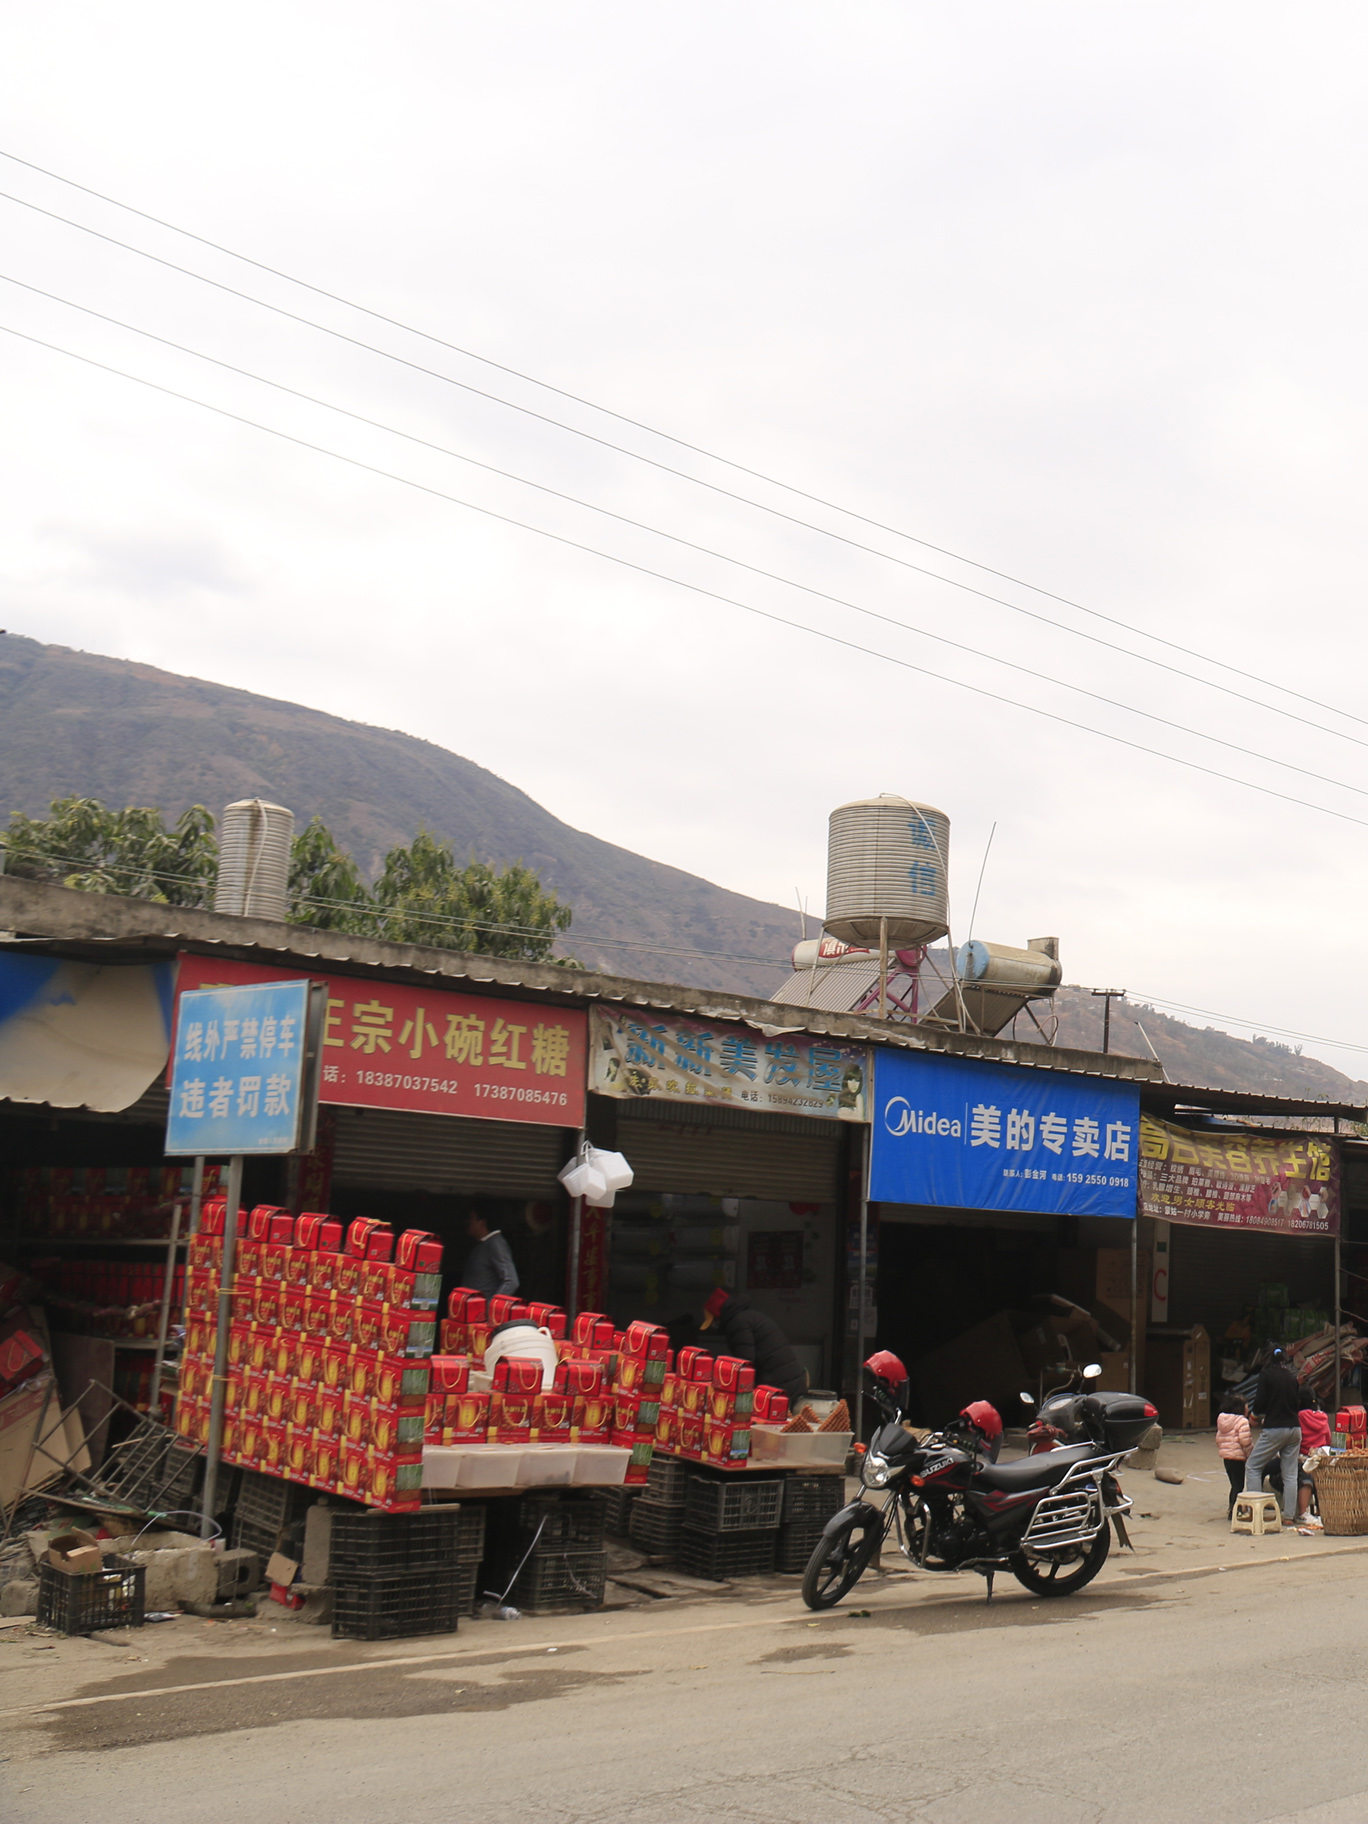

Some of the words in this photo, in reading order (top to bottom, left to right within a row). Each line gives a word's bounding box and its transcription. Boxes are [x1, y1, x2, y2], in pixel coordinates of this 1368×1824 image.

[183, 1014, 296, 1062] 线外严禁停车
[624, 1023, 843, 1093] 新新美发屋
[179, 1073, 292, 1118] 违者罚款
[356, 1070, 458, 1094] 18387037542
[474, 1083, 568, 1106] 17387085476
[884, 1096, 961, 1137] Midea
[970, 1104, 1132, 1162] 美的专卖店
[1067, 1173, 1083, 1184] 159
[1085, 1174, 1107, 1186] 2550
[1109, 1176, 1129, 1188] 0918
[1151, 1193, 1235, 1212] 欢迎男女顾客光临
[920, 1457, 954, 1479] SUZUKI
